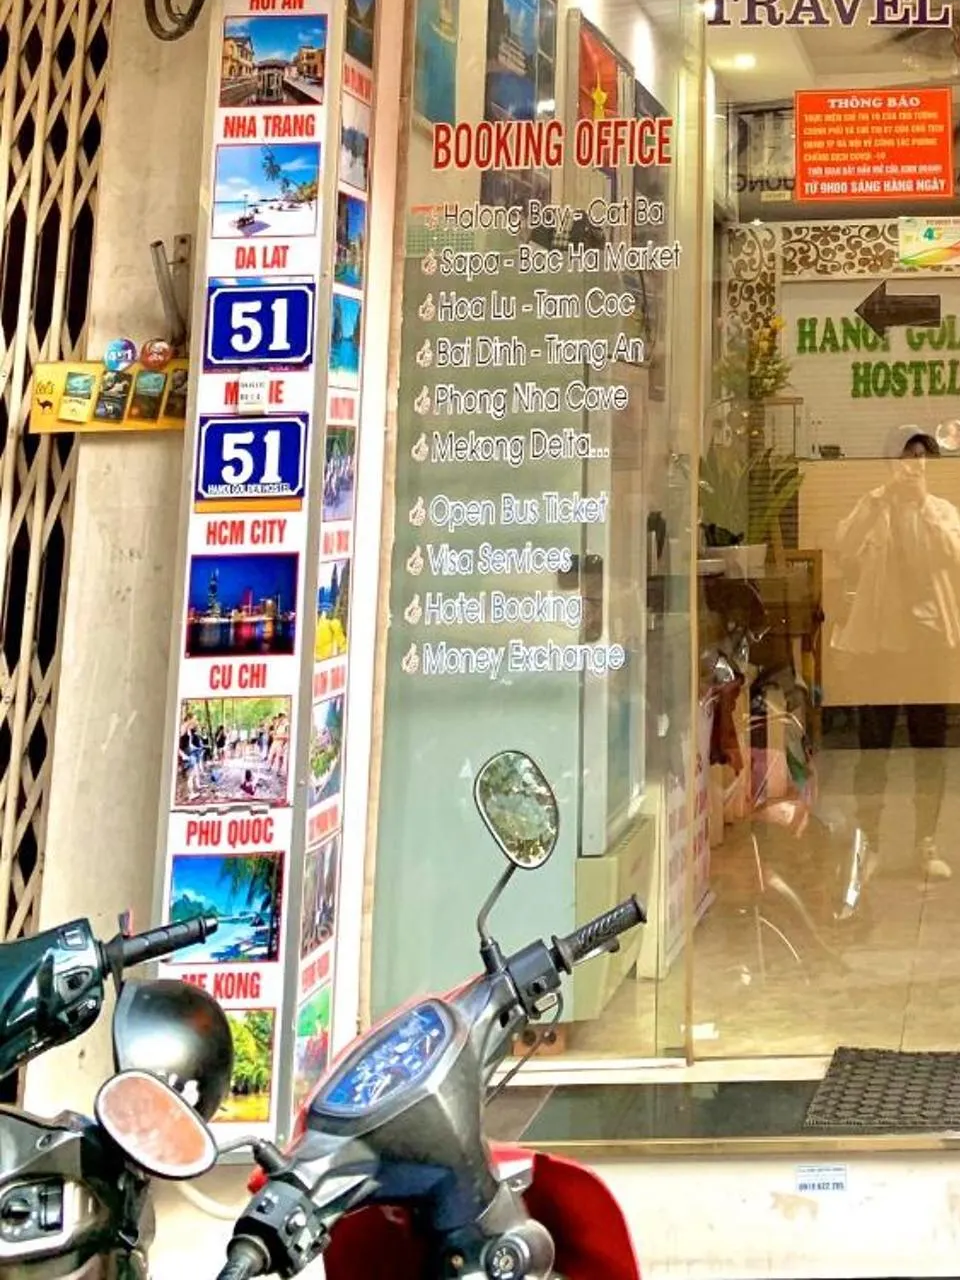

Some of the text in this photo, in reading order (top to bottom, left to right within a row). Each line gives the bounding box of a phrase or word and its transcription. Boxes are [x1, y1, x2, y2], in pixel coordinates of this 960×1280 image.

[223, 114, 316, 138] NHA TRANG
[431, 117, 673, 171] BOOKING OFFICE
[444, 201, 523, 236] Halong
[528, 198, 572, 230] Bay
[588, 195, 630, 227] Cat
[634, 195, 665, 225] Ba
[235, 245, 290, 270] DA LAT
[440, 247, 500, 281] Sapa
[518, 243, 563, 274] Bac
[567, 242, 600, 273] Ha
[604, 238, 682, 271] Market
[438, 291, 486, 322] Hoa
[491, 290, 517, 320] Lu
[534, 288, 581, 319] Tam
[584, 286, 636, 318] Coc
[229, 297, 291, 353] 51
[436, 336, 471, 368] Bai
[475, 335, 526, 367] Dinh
[544, 333, 609, 370] Trang
[610, 332, 645, 363] An
[434, 380, 629, 419] Phong Nha Cave
[220, 429, 283, 485] 51
[431, 429, 525, 467] Mekong
[428, 491, 609, 533] Open Bus Ticket
[206, 519, 287, 545] HCM CITY
[426, 541, 573, 576] Visa Services
[424, 590, 583, 631] Hotel Booking
[209, 664, 267, 691] CU CHI
[422, 639, 626, 681] Money Exchange
[186, 819, 222, 847] PHU
[227, 817, 274, 846] QUOC
[213, 971, 261, 1000] KONG
